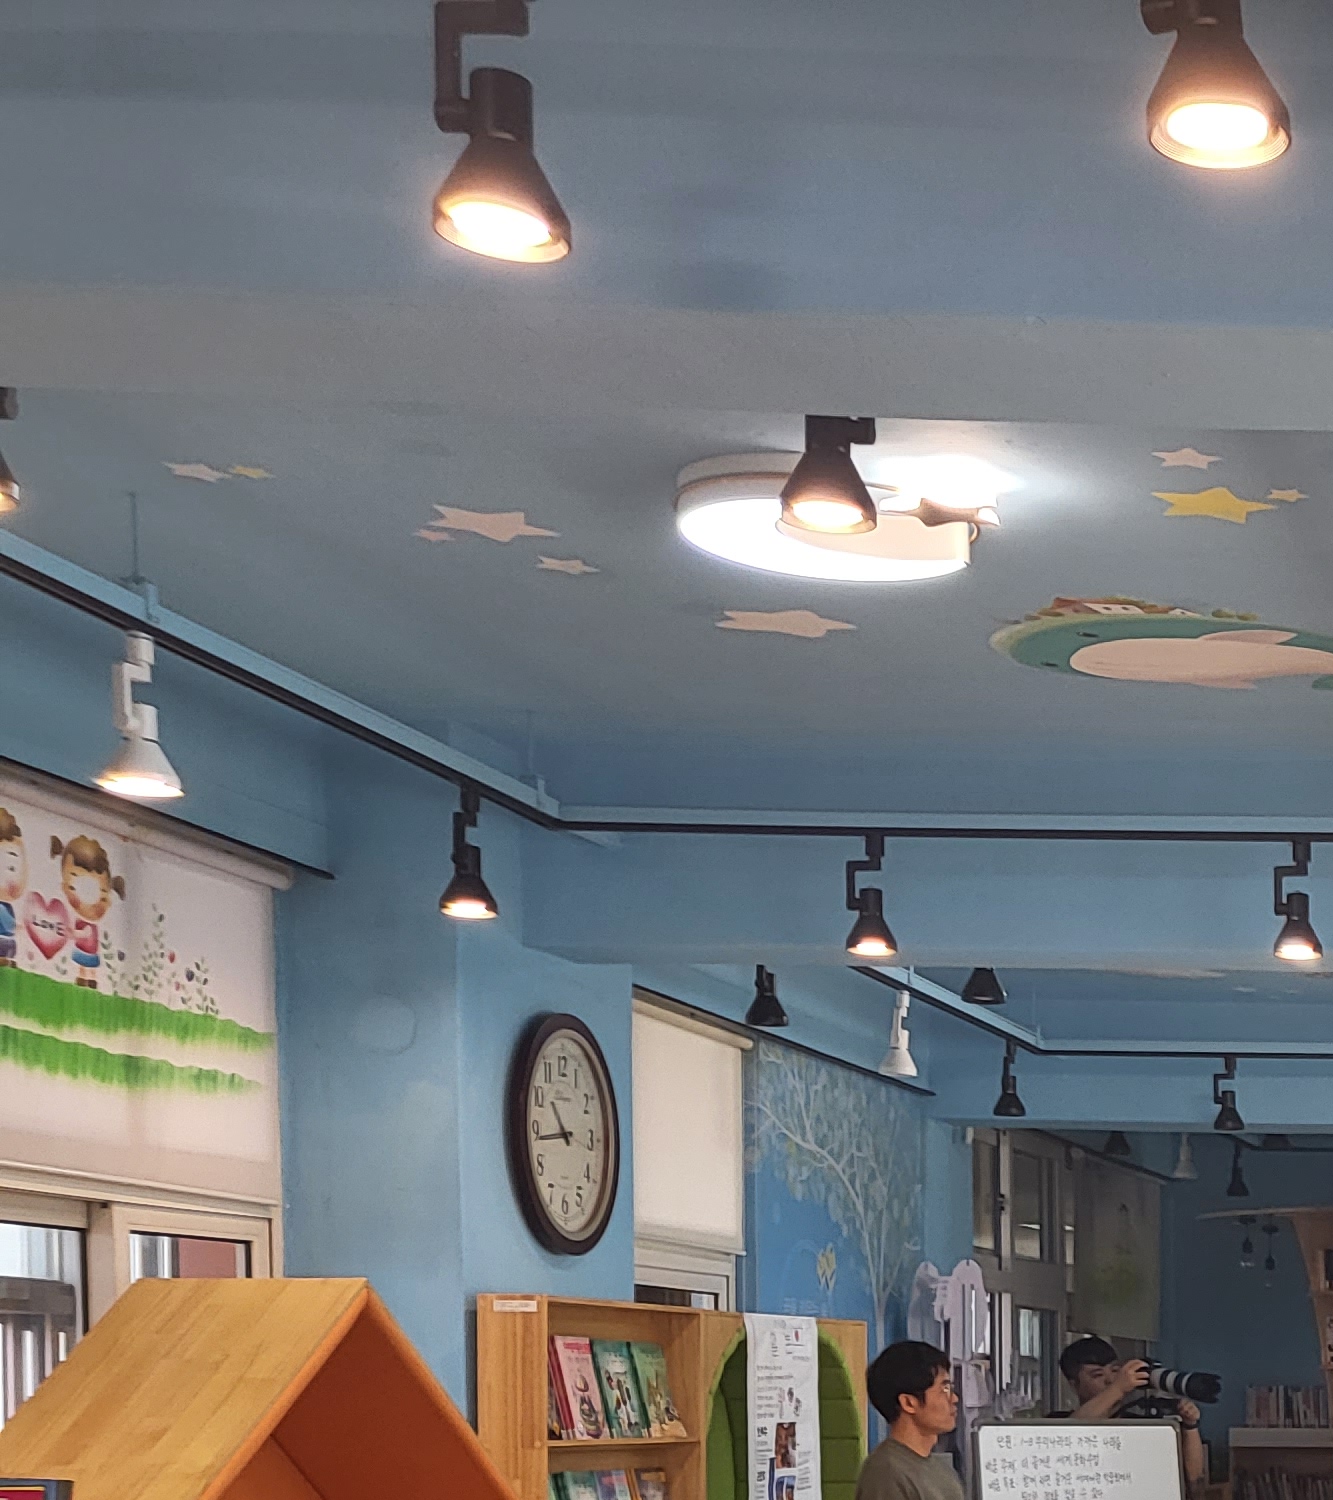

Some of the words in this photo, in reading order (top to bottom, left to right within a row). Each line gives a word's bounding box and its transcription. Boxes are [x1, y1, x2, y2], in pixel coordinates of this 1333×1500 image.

[543, 1061, 552, 1083] 11
[557, 1055, 568, 1078] 12
[573, 1068, 579, 1089] 1
[534, 1086, 545, 1108] 10
[583, 1093, 590, 1115] 2
[532, 1119, 540, 1141] 9
[587, 1129, 594, 1151] 3
[536, 1153, 545, 1177] 8
[583, 1163, 591, 1184] 4
[547, 1182, 555, 1206] 7
[561, 1193, 569, 1215] 6
[575, 1185, 583, 1208] 5
